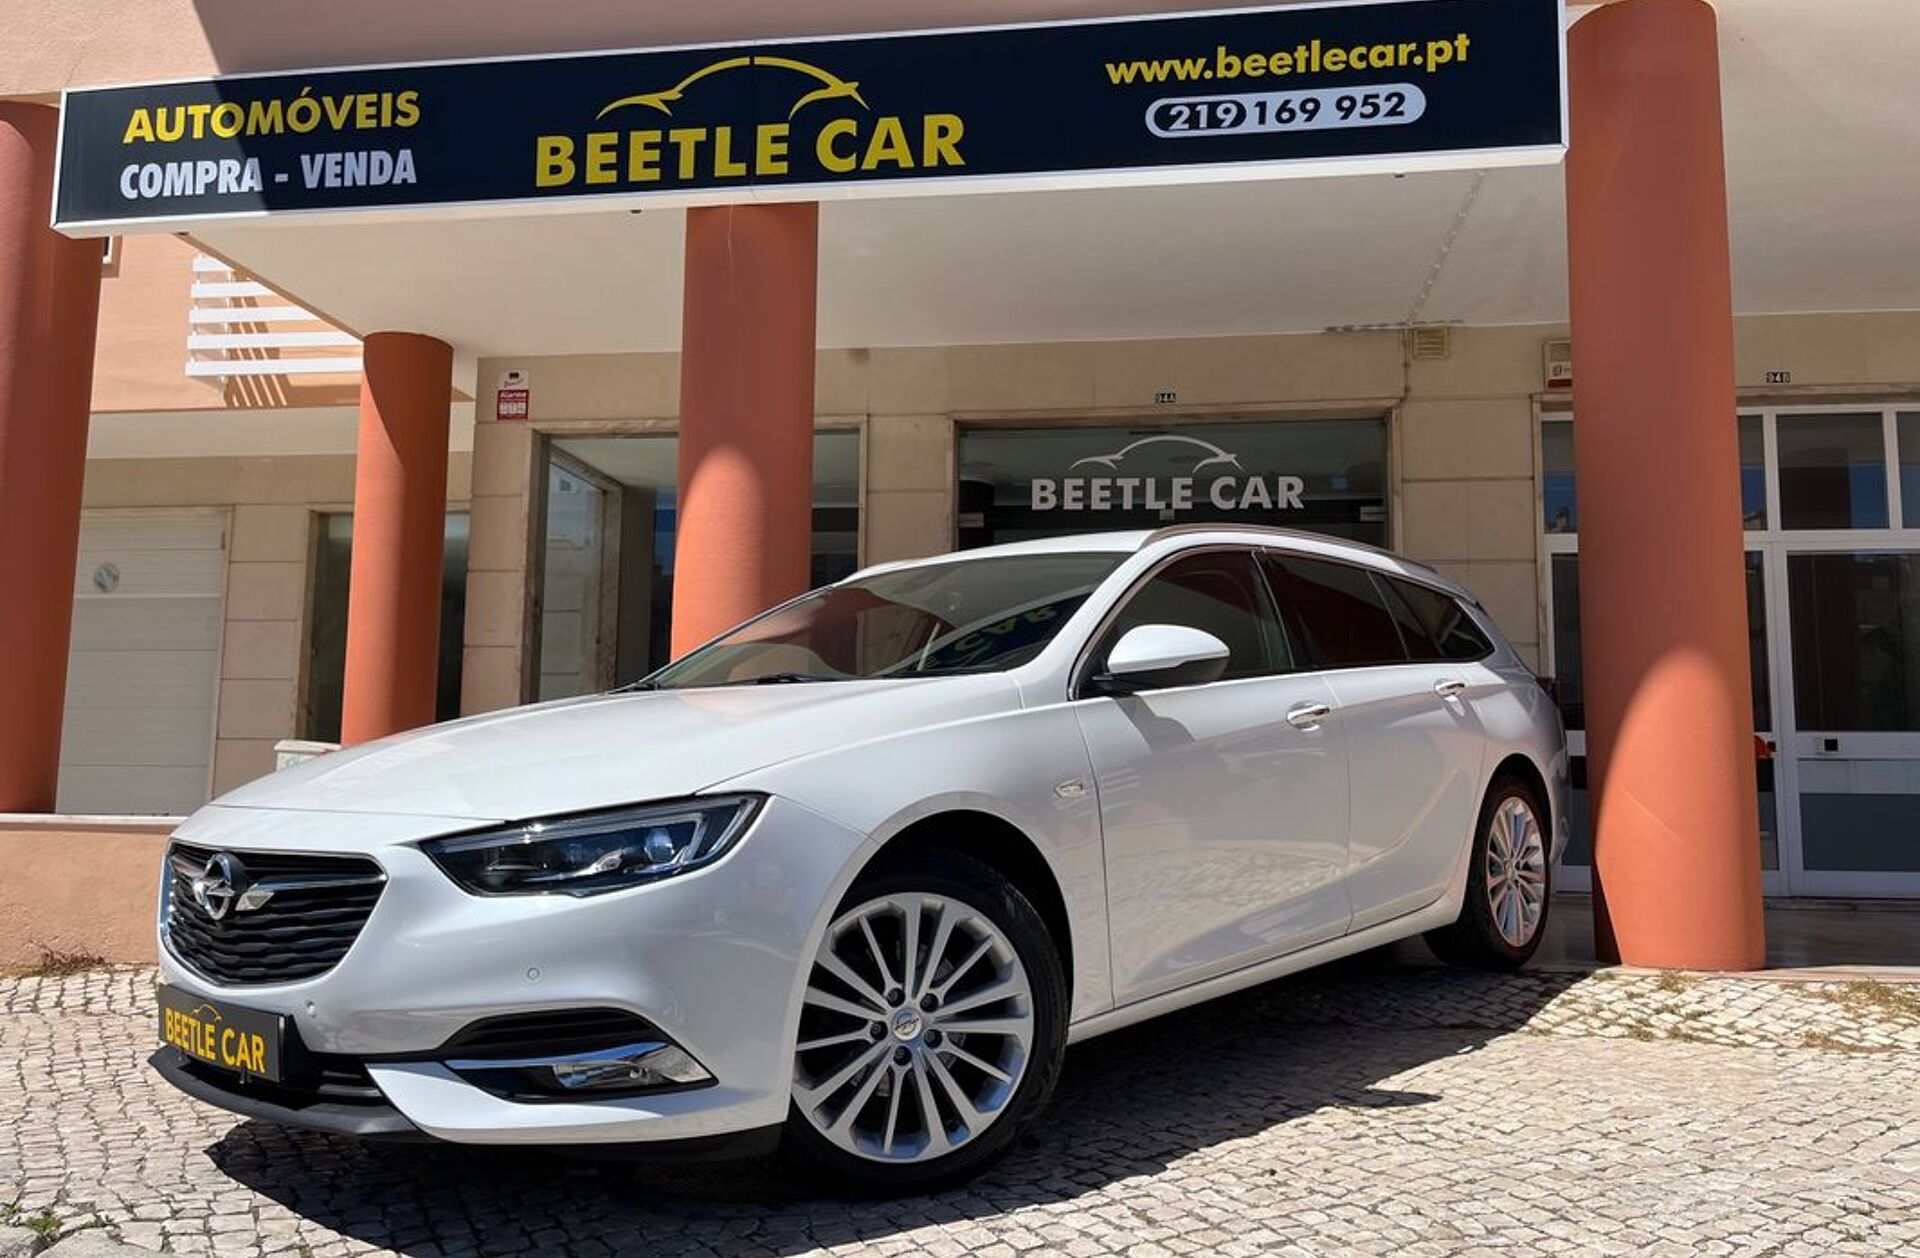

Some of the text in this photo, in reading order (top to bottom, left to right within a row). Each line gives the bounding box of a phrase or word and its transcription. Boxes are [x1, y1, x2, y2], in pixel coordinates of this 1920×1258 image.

[1106, 33, 1469, 86] www.beetlecar.pt
[123, 87, 420, 144] AUTOMÓVEIS
[1168, 92, 1406, 131] 219 169 952
[120, 157, 263, 200] COMPRA
[300, 149, 417, 189] VENDA
[536, 113, 965, 187] BEETLE CAR
[1031, 475, 1304, 511] BEETLE CAR
[165, 1007, 265, 1073] BEETLE CAR
